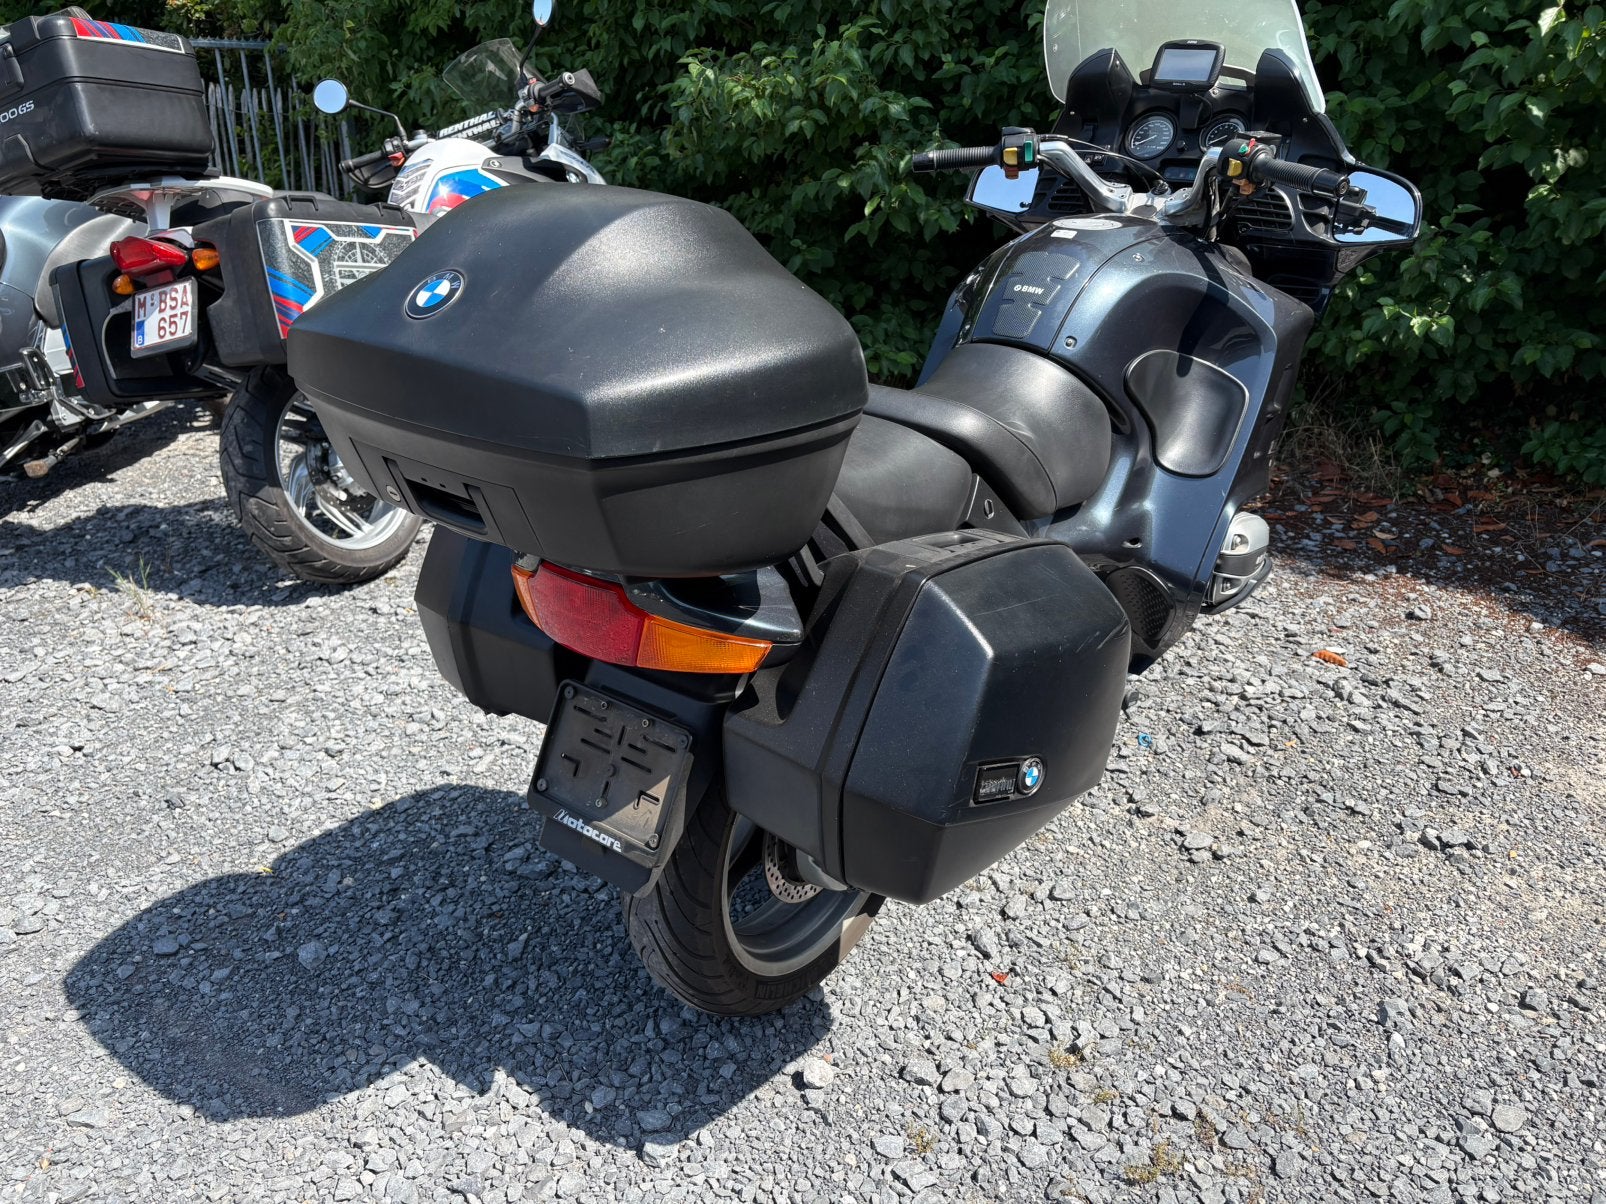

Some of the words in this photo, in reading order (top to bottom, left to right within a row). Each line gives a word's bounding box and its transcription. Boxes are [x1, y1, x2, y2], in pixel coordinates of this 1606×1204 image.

[0, 100, 35, 123] 00GS
[438, 111, 497, 138] RENTHAL
[450, 119, 499, 139] NTHAL
[137, 296, 147, 319] M
[158, 284, 190, 314] BSA
[1021, 285, 1045, 295] BMW
[157, 310, 189, 339] 657
[553, 808, 622, 853] Motocare
